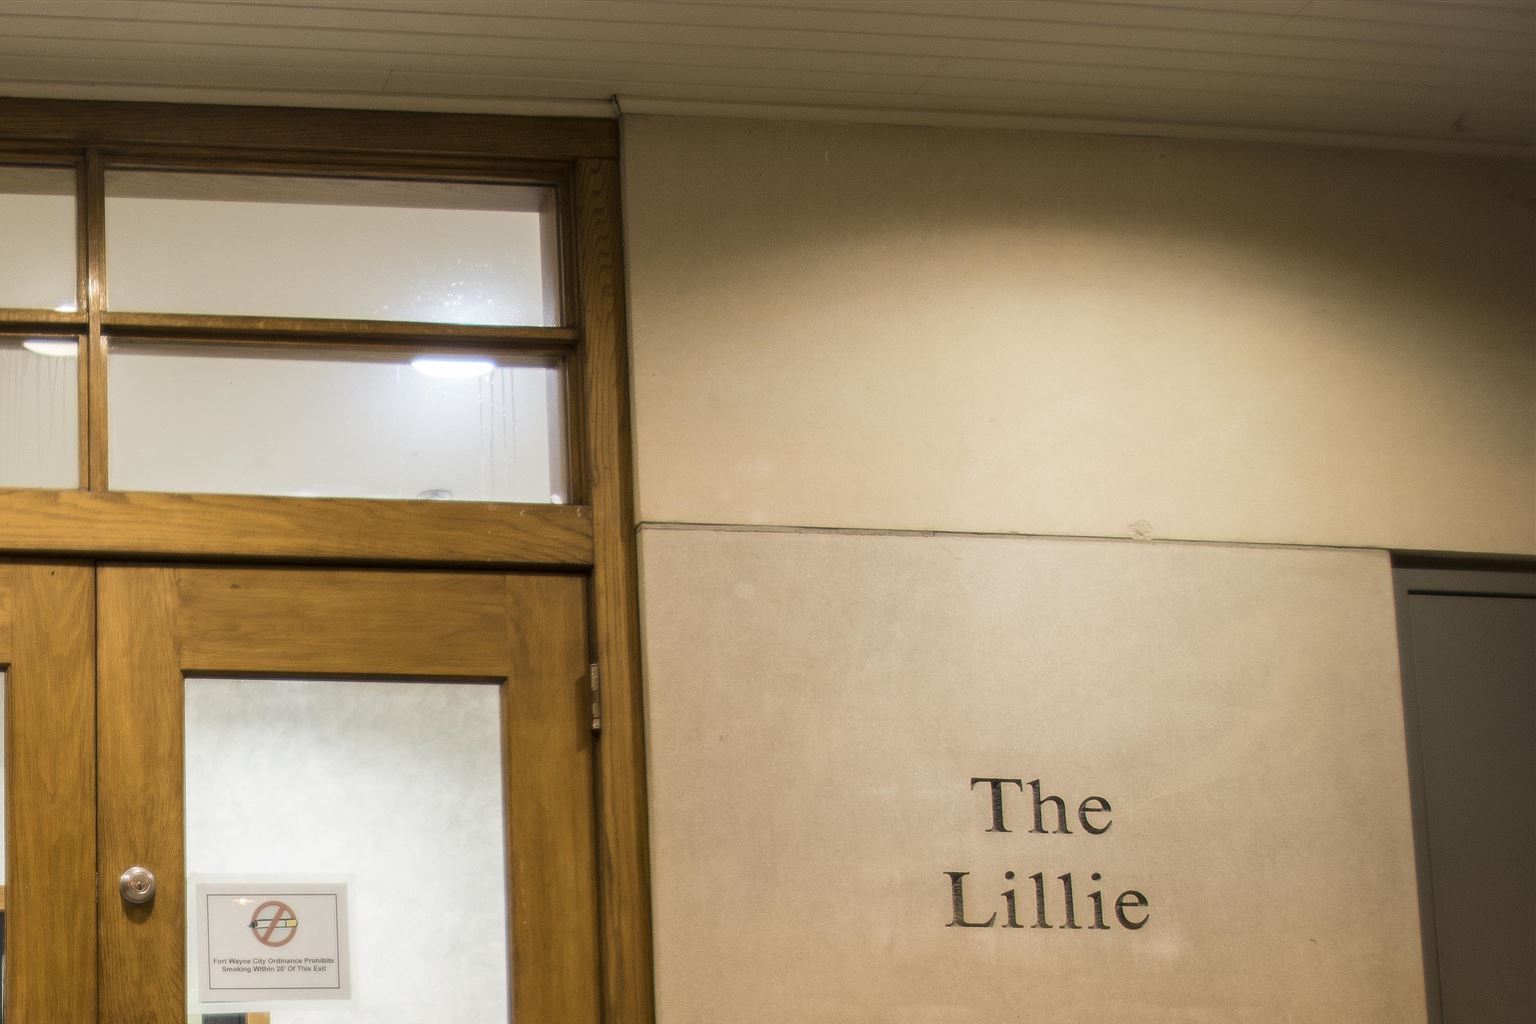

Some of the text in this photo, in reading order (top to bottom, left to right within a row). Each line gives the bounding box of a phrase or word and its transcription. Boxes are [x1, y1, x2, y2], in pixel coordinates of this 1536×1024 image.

[969, 775, 1114, 836] The
[942, 870, 1151, 931] Lillie
[228, 958, 251, 966] Wayne
[252, 957, 266, 966] City
[268, 957, 303, 965] Ordinance
[304, 957, 335, 965] Prohibits
